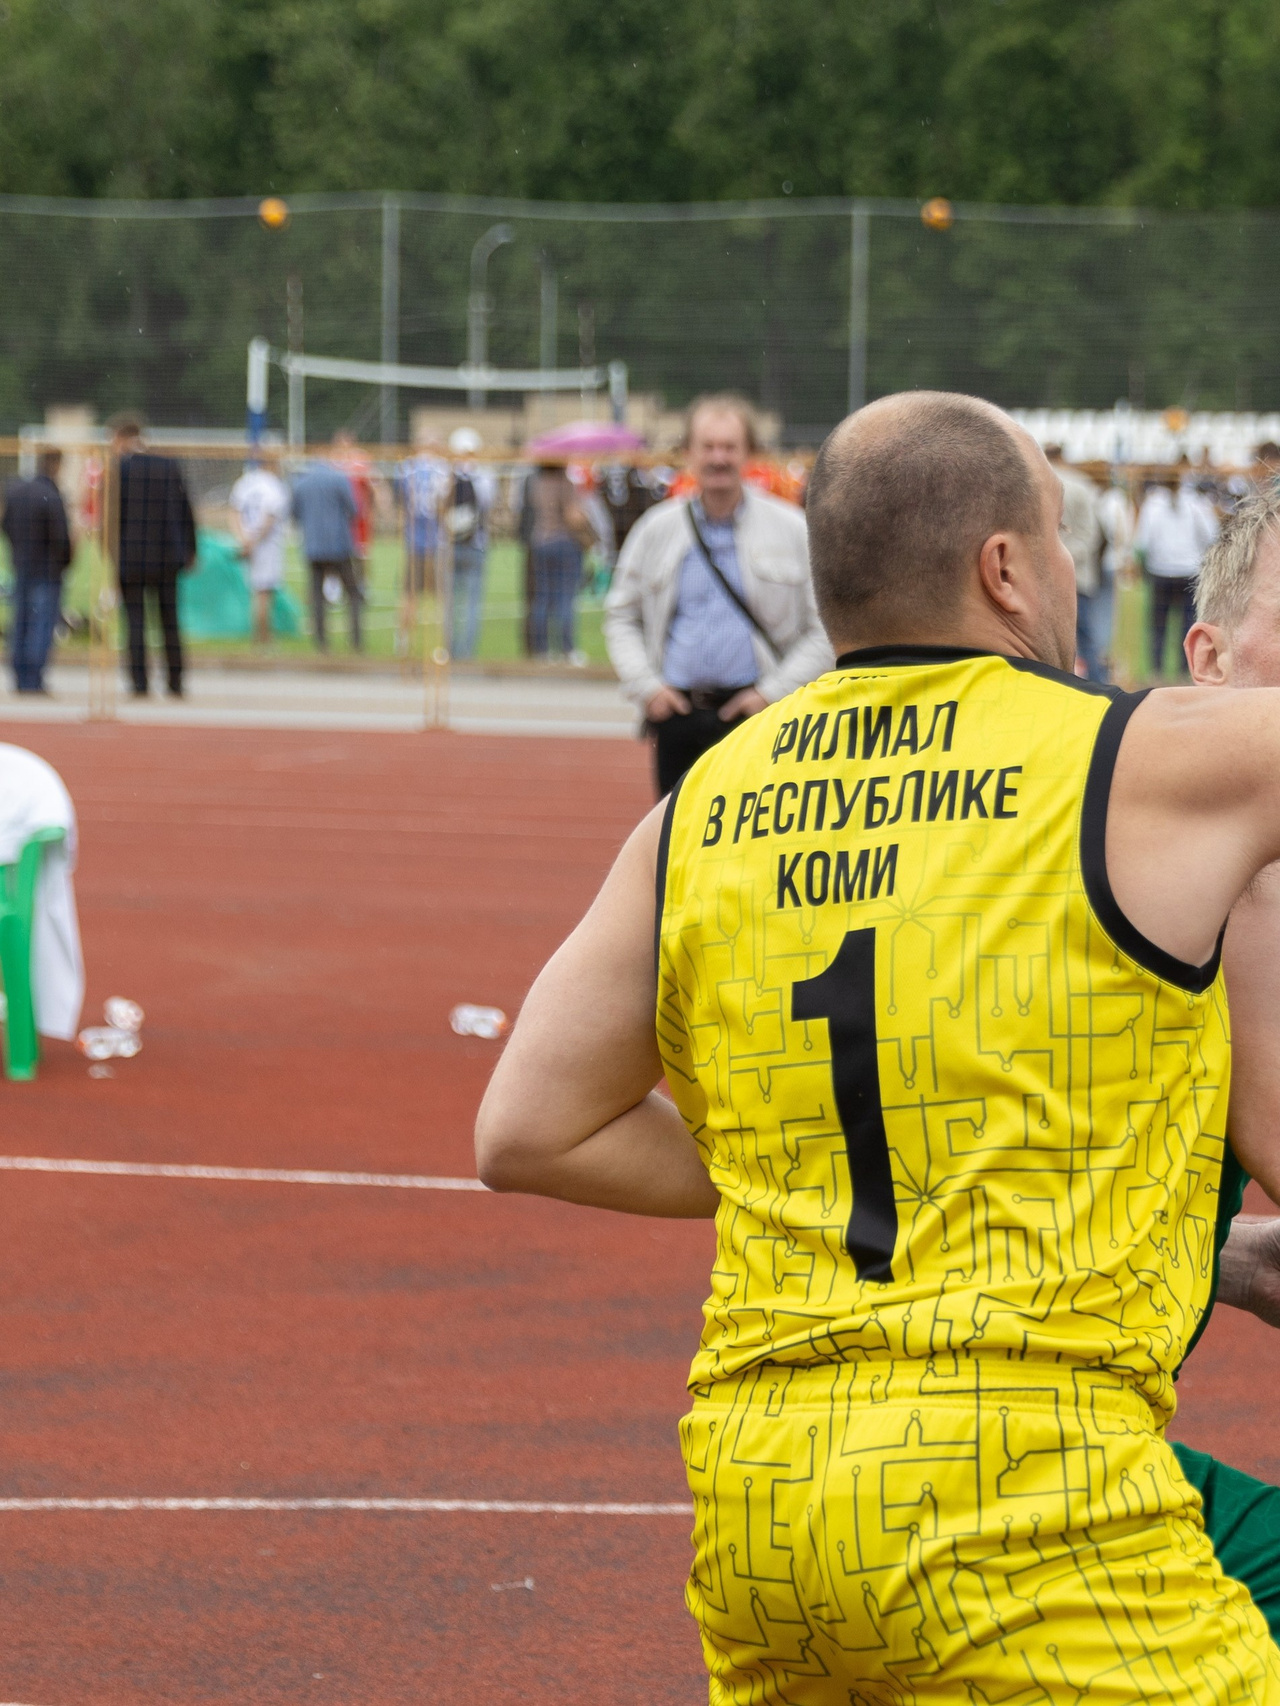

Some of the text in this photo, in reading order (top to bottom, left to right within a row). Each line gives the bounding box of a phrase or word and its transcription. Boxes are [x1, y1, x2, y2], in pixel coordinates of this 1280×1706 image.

[770, 700, 958, 764] ФИЛИАЛ
[702, 766, 1023, 848] В РЕСПУБЛИКЕ
[776, 843, 899, 909] КОМИ
[791, 926, 898, 1283] 1
